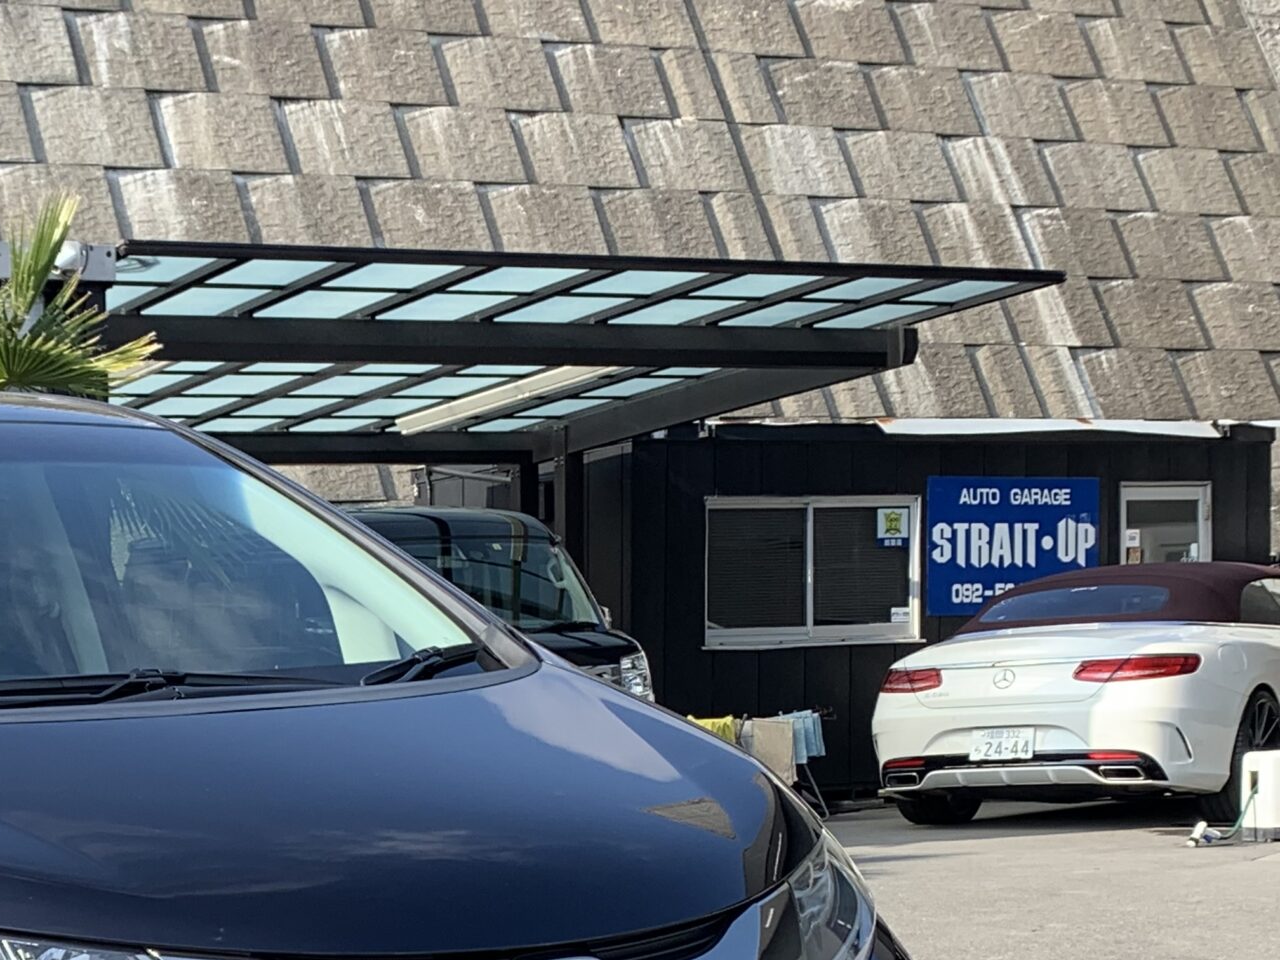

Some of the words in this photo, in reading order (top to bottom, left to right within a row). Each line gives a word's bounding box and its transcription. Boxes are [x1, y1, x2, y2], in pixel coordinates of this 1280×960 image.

[959, 488, 1000, 505] AUTO
[1010, 488, 1071, 506] GARAGE
[983, 740, 1029, 757] 24-44
